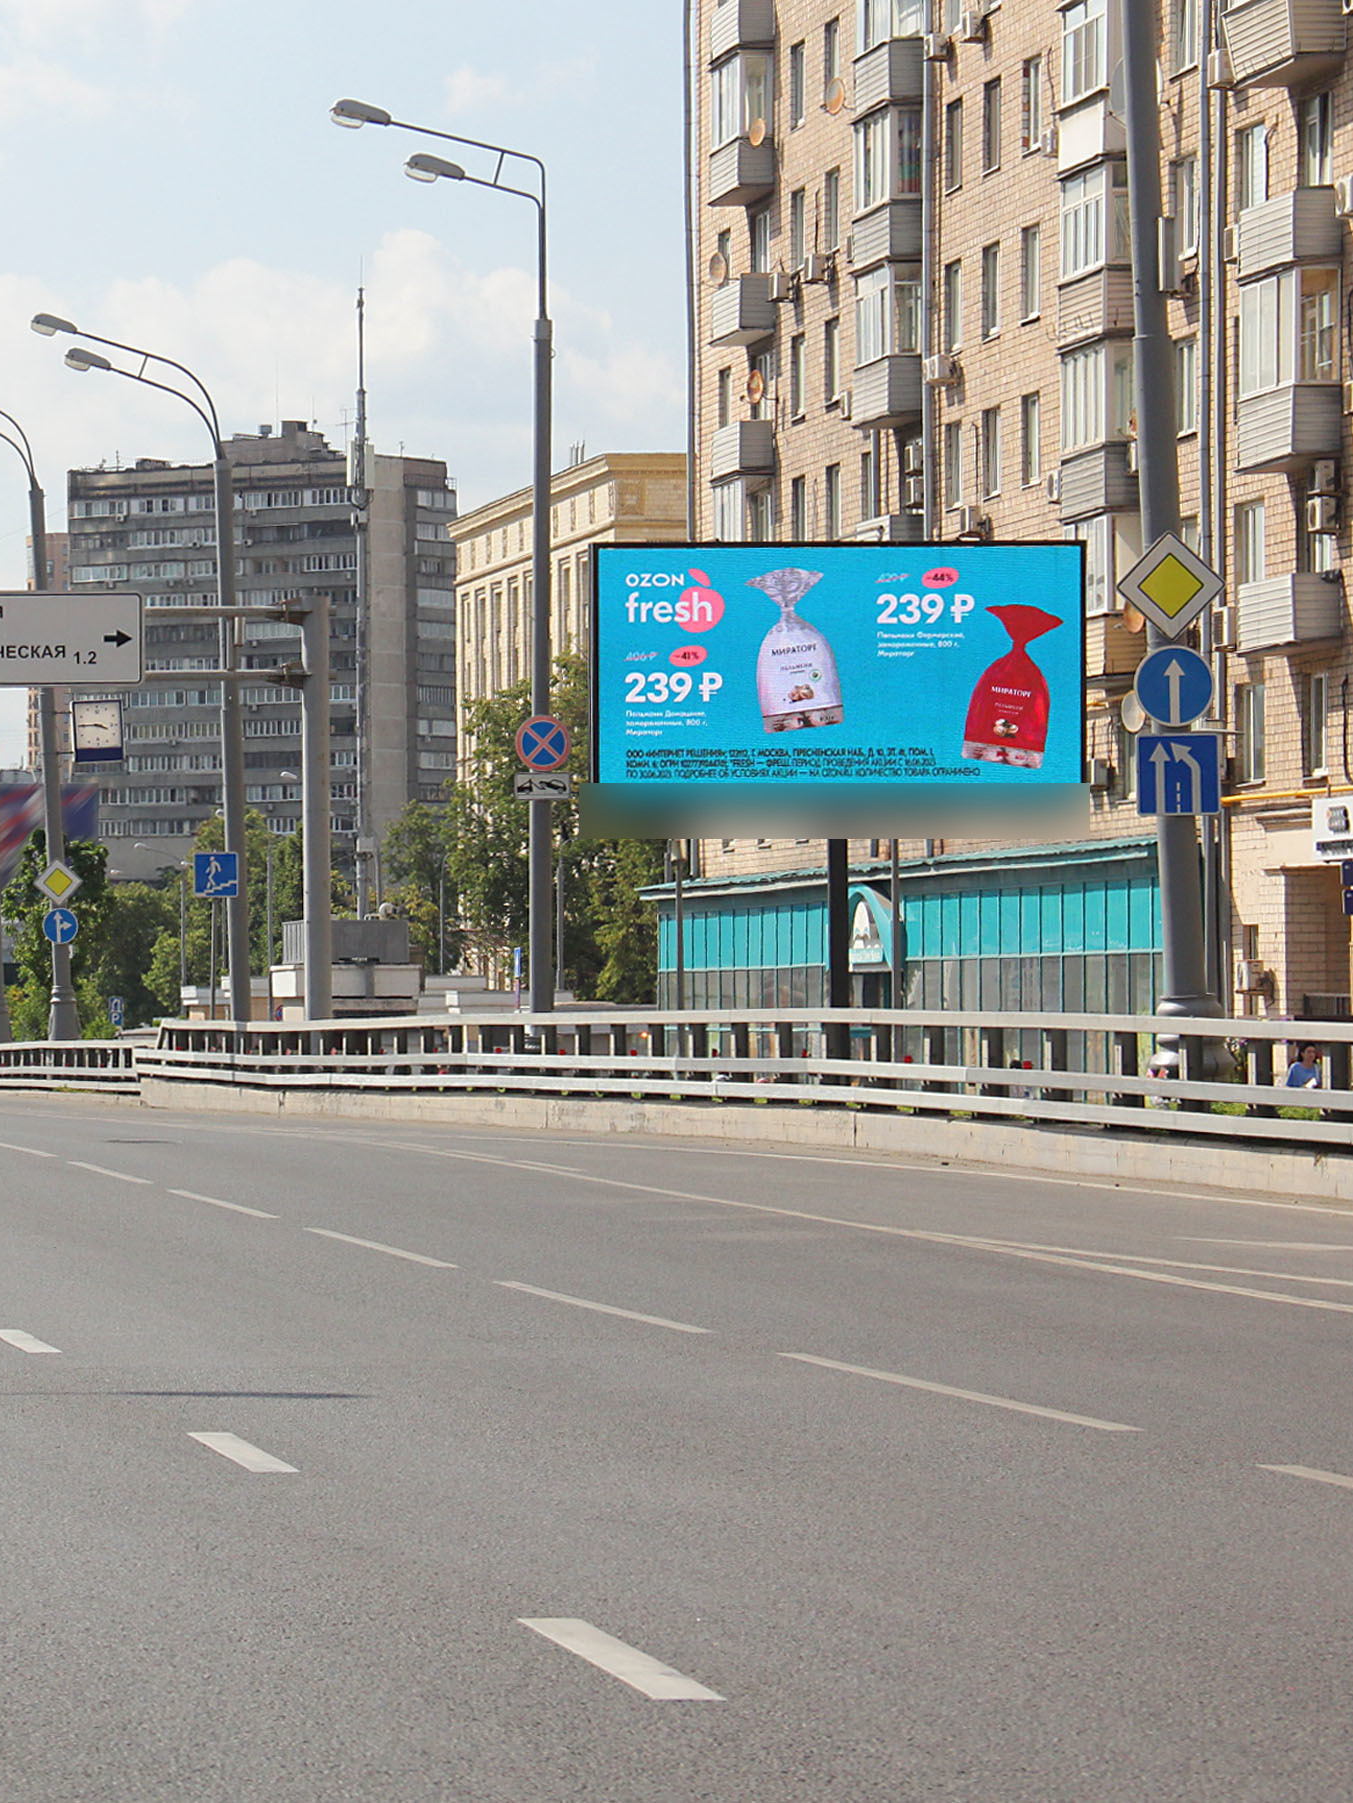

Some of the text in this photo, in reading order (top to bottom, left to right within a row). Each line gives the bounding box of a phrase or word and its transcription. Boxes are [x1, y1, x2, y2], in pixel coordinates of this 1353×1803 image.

[625, 573, 685, 587] OZON
[625, 591, 713, 623] fresh
[876, 593, 945, 624] 239
[73, 651, 97, 665] 1.2
[625, 672, 693, 703] 239
